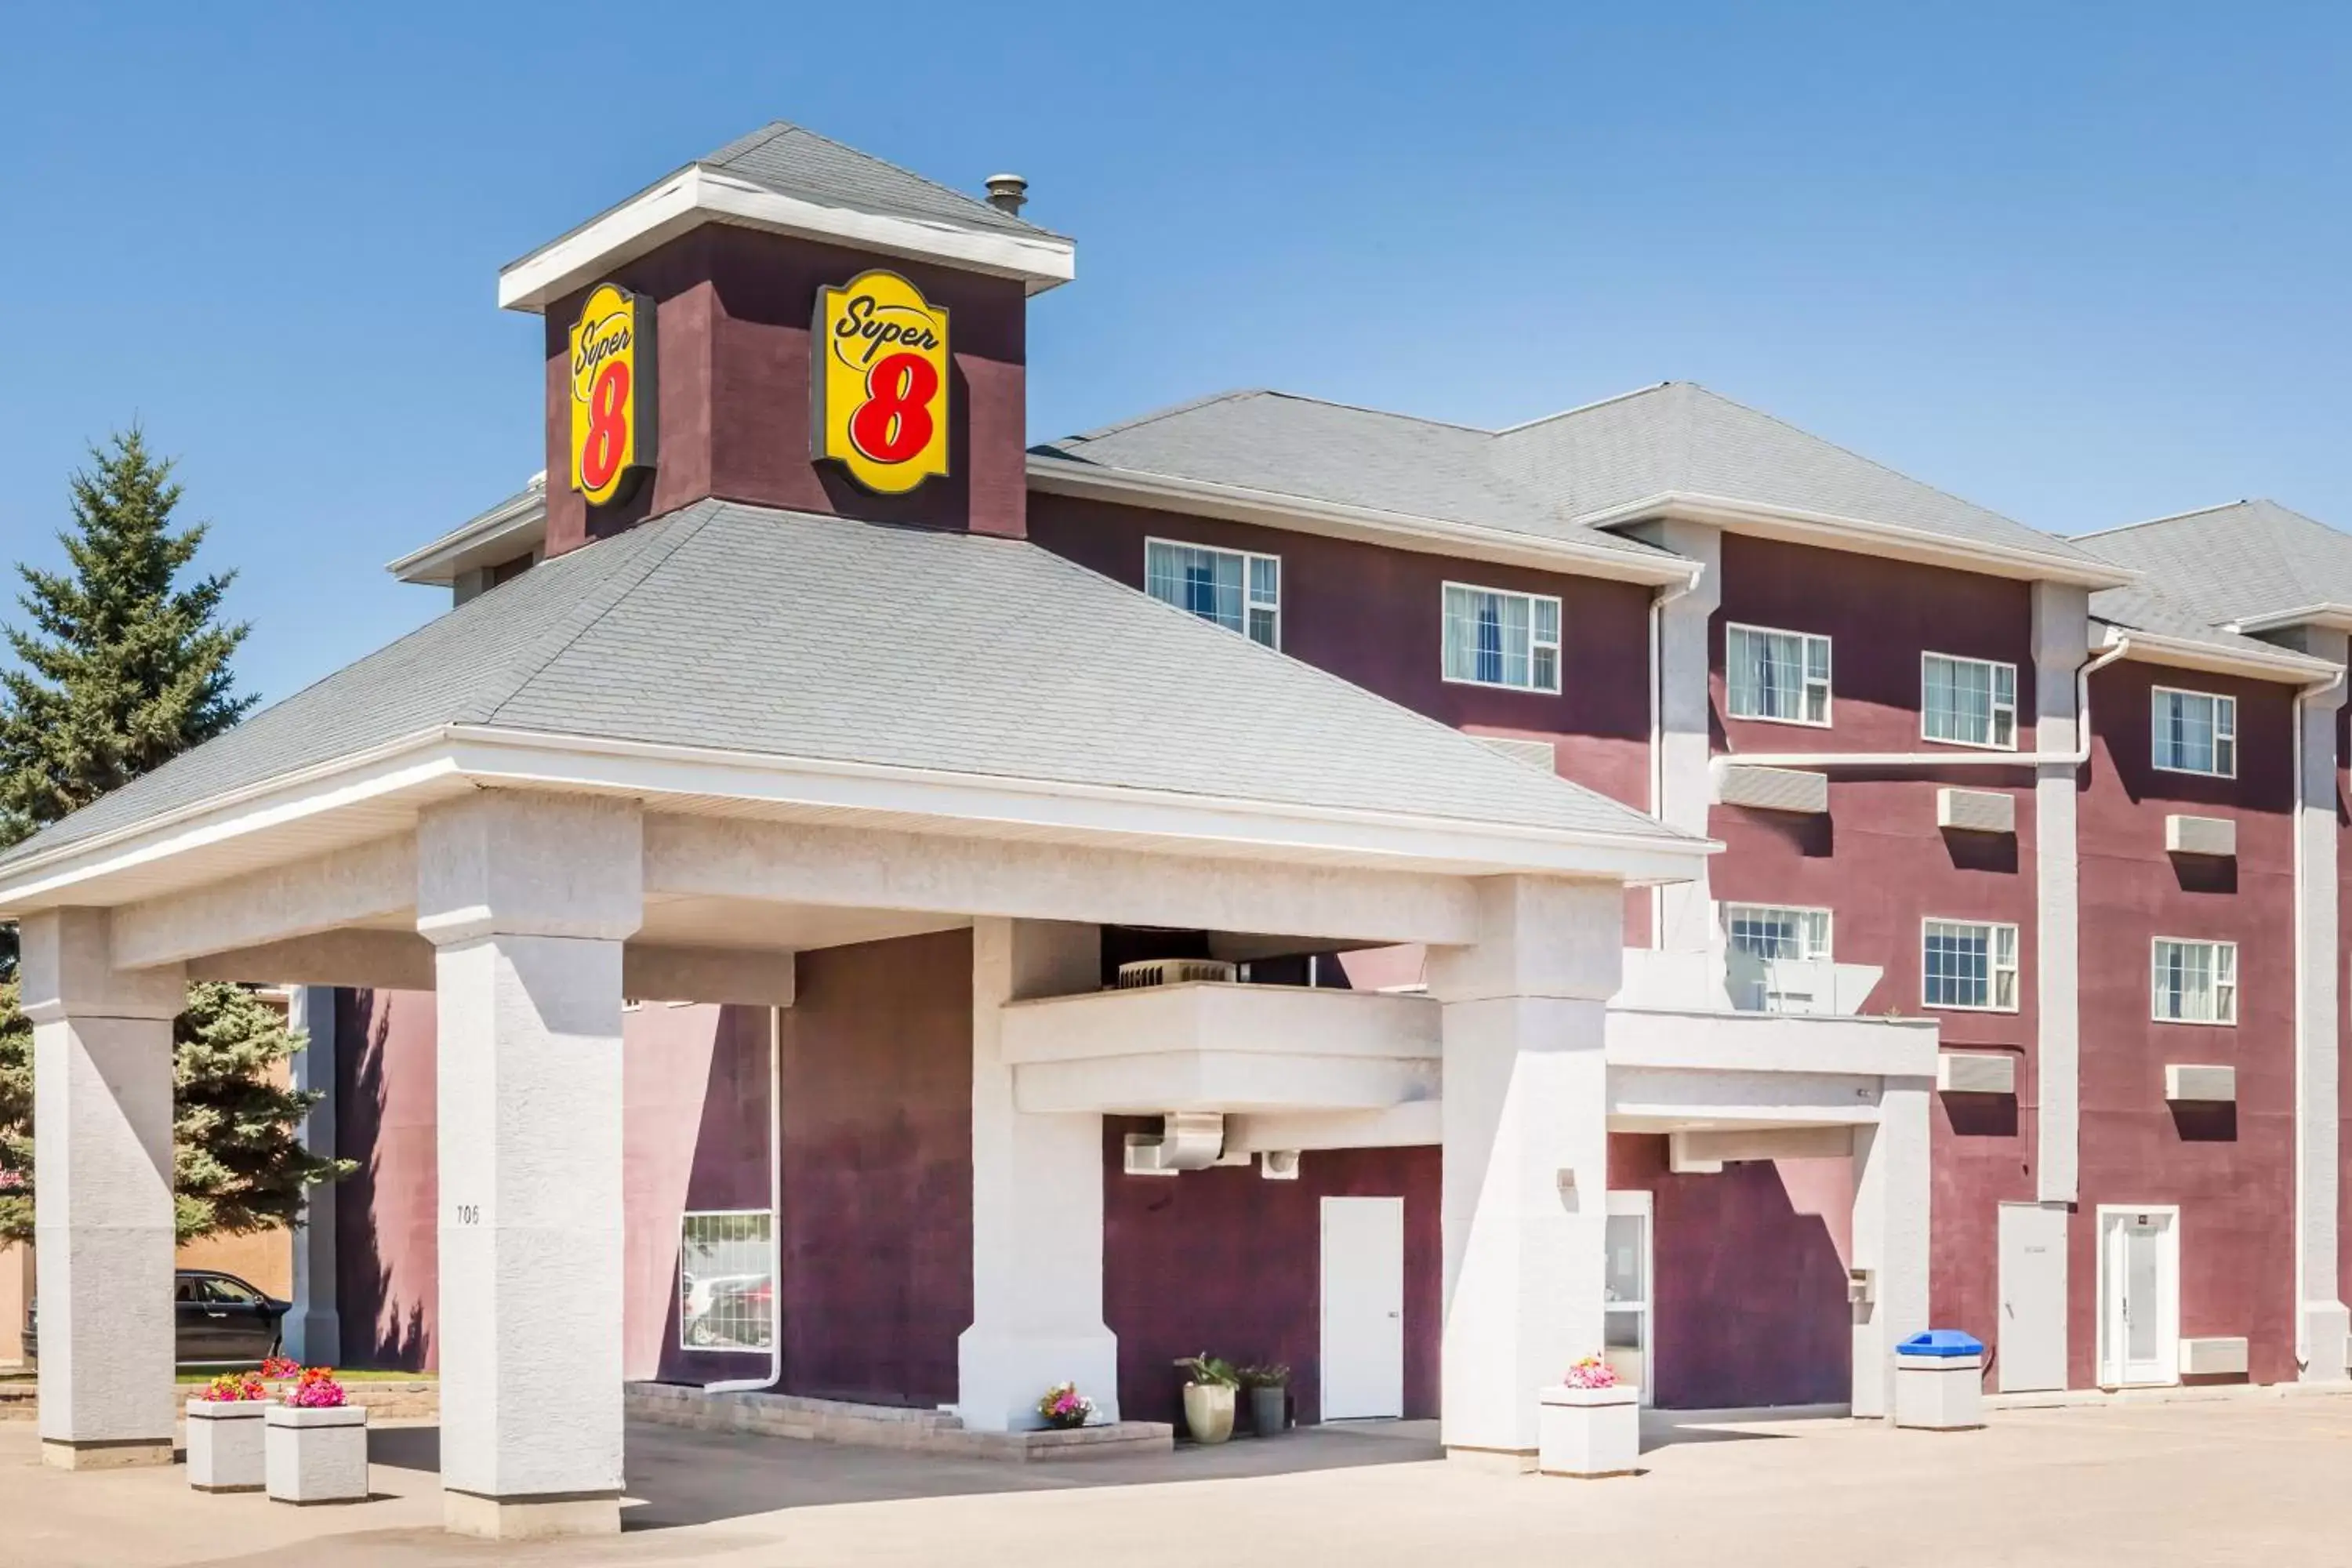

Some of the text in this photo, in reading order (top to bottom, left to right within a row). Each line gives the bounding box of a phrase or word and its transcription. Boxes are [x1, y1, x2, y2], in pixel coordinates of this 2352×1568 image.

[575, 320, 630, 391] Super
[835, 295, 939, 363] Super
[580, 361, 630, 492] 8
[848, 352, 938, 464] 8
